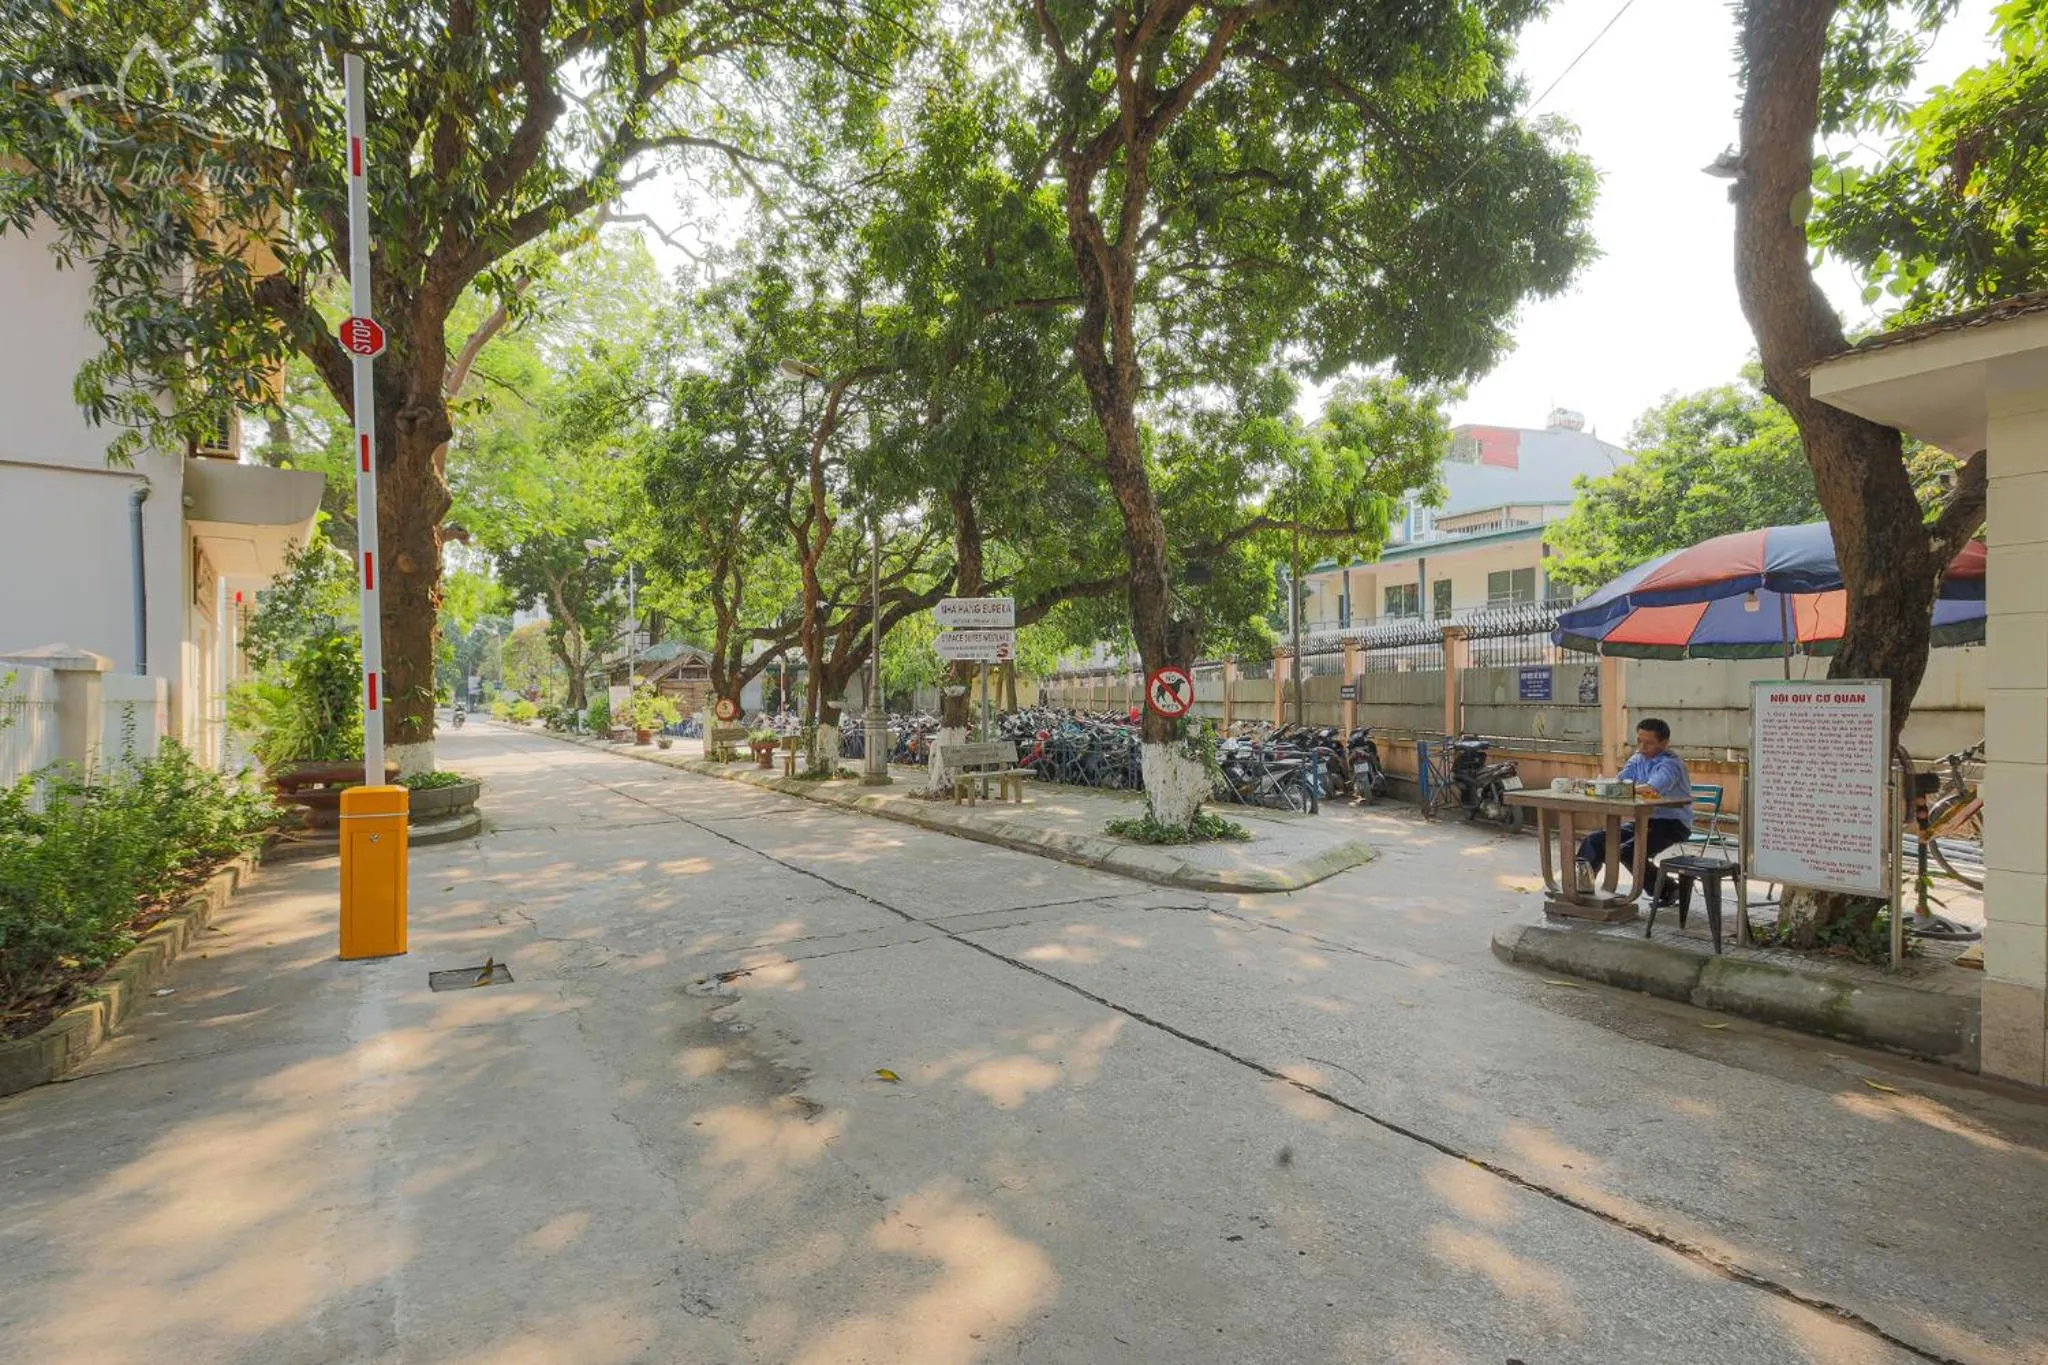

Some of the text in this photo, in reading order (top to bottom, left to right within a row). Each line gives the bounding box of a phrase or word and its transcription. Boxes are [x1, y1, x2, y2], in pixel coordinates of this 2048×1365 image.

[352, 319, 372, 353] STOP
[1770, 693, 1866, 705] NỘI QUY CƠ QUAN
